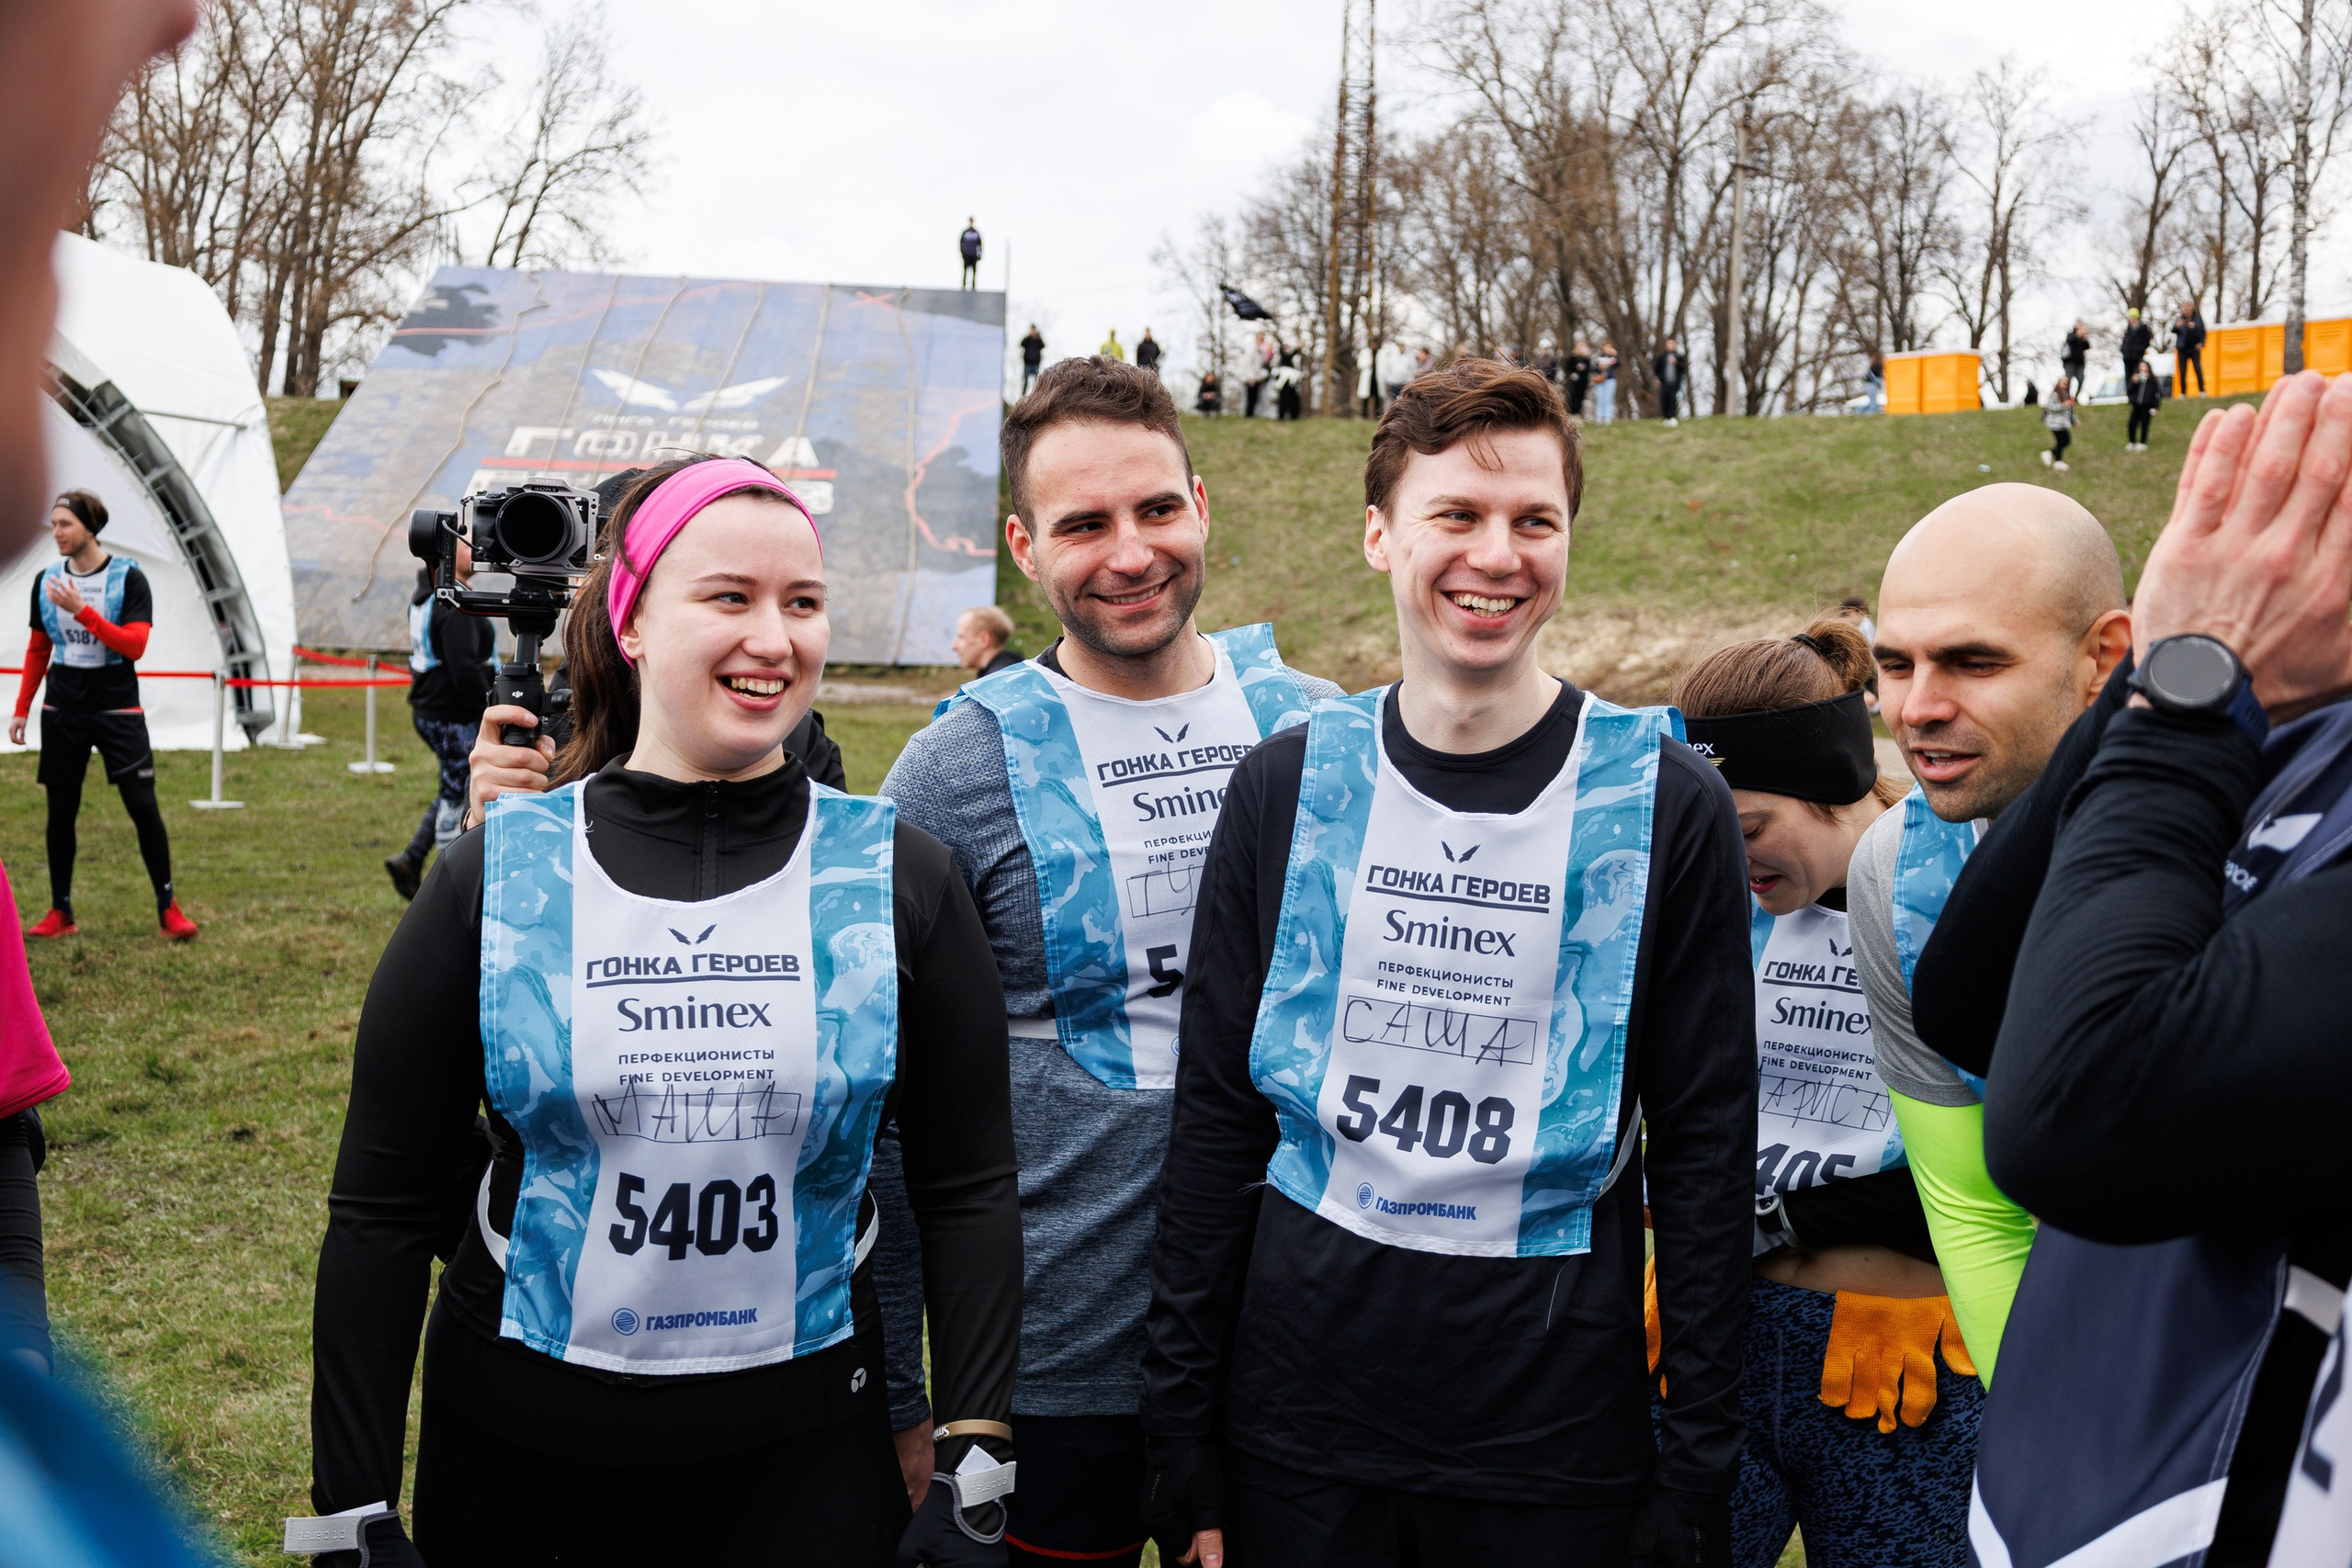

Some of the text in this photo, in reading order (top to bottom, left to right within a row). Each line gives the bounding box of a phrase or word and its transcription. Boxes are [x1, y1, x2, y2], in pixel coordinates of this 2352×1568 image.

[1096, 752, 1175, 782] ГОНКА
[1132, 786, 1228, 822] Smine
[1144, 829, 1215, 849] ПЕРФЕКЦИ
[1148, 852, 1175, 864] FINE
[1366, 864, 1552, 905] ГОНКА ГЕРОЕВ
[1382, 908, 1516, 957] Sminex
[586, 952, 801, 980] ГОНКА ГЕРОЕВ
[1377, 961, 1514, 989] ПЕРФЕКЦИОНИСТЫ
[1764, 961, 1826, 982] ГОНКА
[1376, 979, 1512, 1007] FINE DEVELOPMENT
[616, 995, 773, 1032] Sminex
[1342, 999, 1527, 1067] САША
[618, 1048, 775, 1066] ПЕРФЕКЦИОНИСТЫ
[1763, 1040, 1876, 1066] ПЕРФЕКЦИОНИСТЫ
[619, 1068, 775, 1086] FINE DEVELOPMENT
[1760, 1056, 1872, 1081] FINE DEVELOPMENT
[1336, 1074, 1516, 1166] 5408
[1756, 1143, 1857, 1196] 405
[607, 1172, 779, 1261] 5403
[1374, 1196, 1477, 1221] ГАЗПРОМБАНК
[645, 1308, 758, 1332] ГАЗПРОМБАНК
